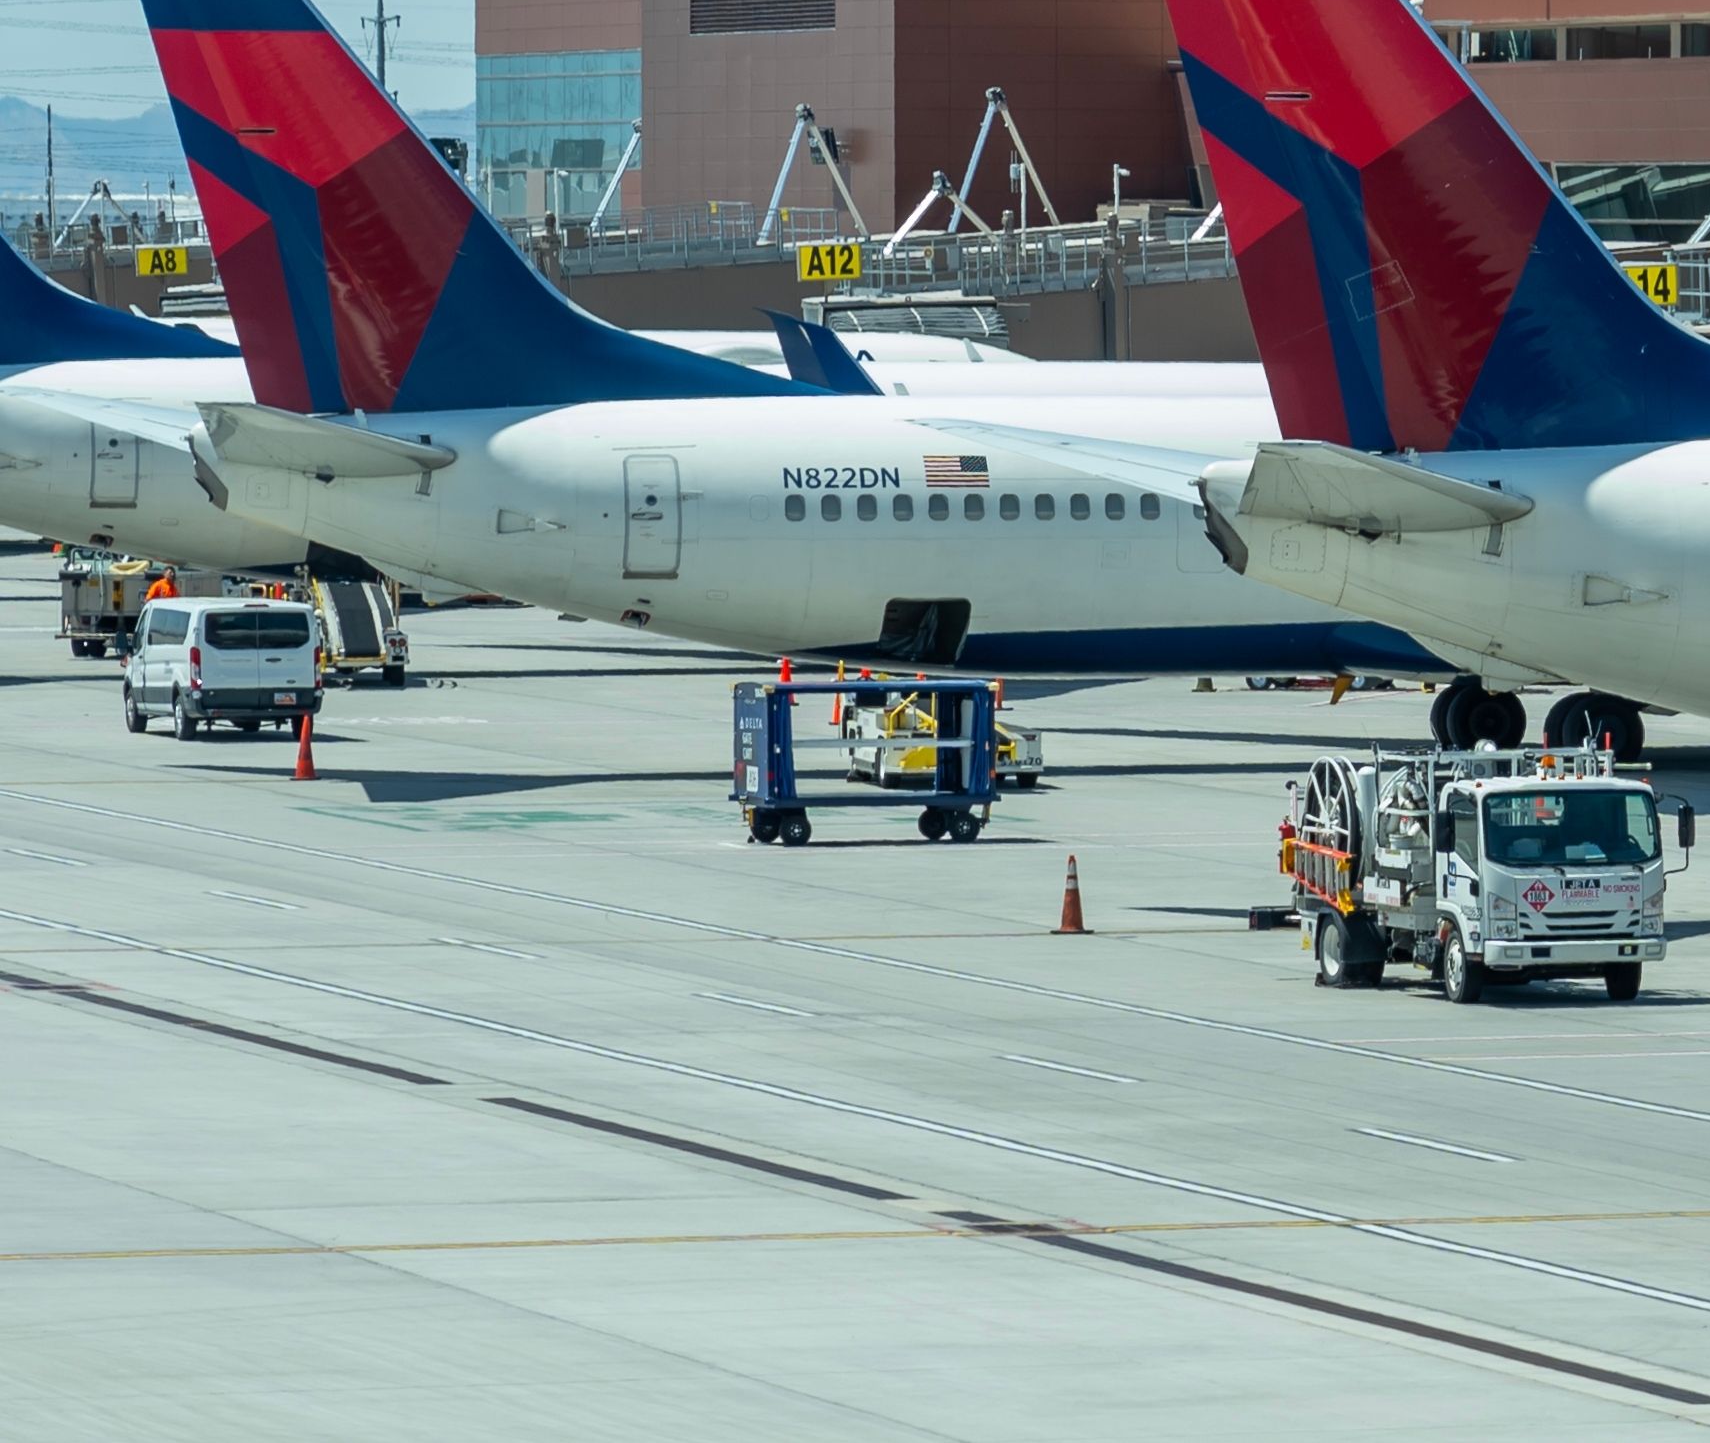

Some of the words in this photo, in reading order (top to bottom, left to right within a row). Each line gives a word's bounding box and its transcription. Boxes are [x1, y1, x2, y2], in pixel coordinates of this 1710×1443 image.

[150, 249, 177, 274] A8
[807, 245, 854, 276] A12
[783, 467, 900, 489] N822DN
[745, 717, 762, 729] DELTA
[1569, 879, 1587, 889] JET
[1588, 879, 1597, 889] A
[1603, 885, 1612, 893] NO
[1614, 884, 1640, 893] SMOKING
[1562, 889, 1599, 899] FLAMMABLE
